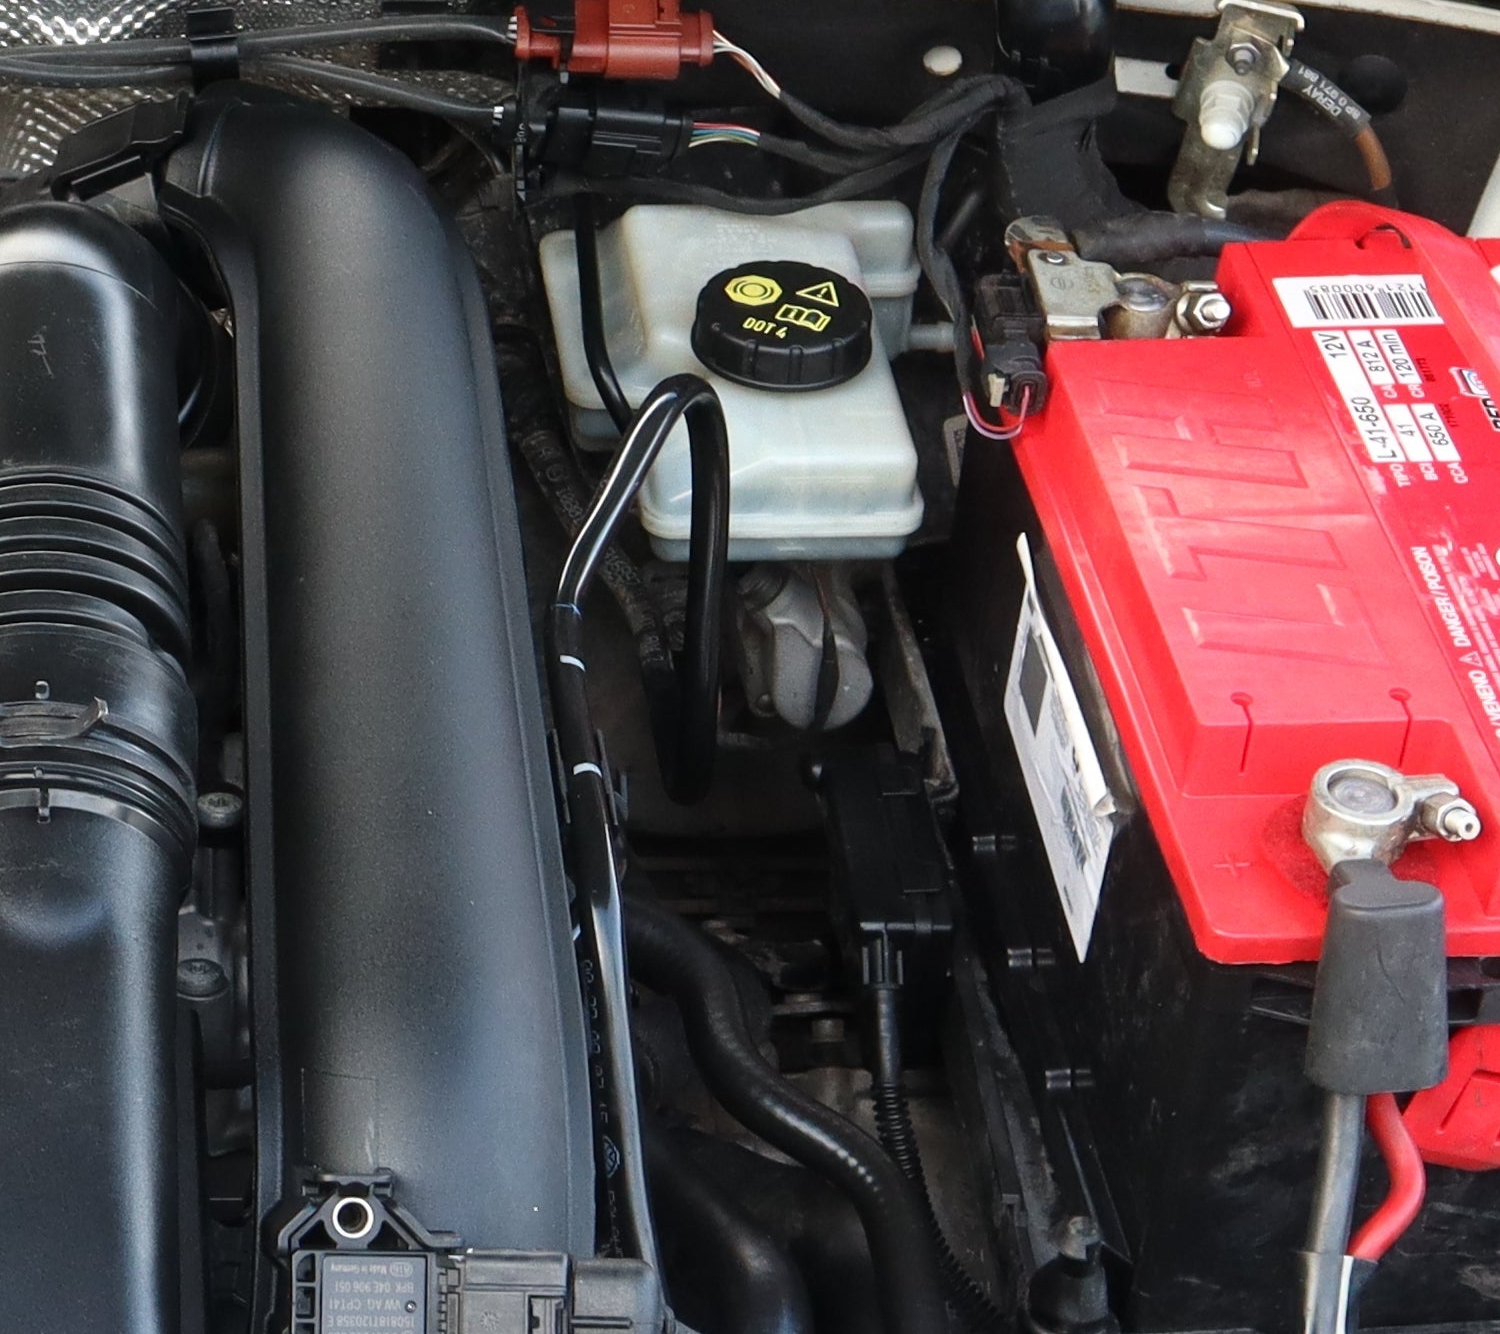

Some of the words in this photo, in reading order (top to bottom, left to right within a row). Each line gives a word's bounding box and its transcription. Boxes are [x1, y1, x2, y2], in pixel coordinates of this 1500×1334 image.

[742, 316, 775, 335] DOT
[775, 325, 788, 339] 4
[1318, 333, 1347, 358] 12V
[1356, 340, 1375, 350] A
[1383, 333, 1404, 355] min
[1363, 353, 1385, 372] 812
[1394, 357, 1415, 377] 120
[1382, 384, 1398, 399] CA
[1420, 411, 1437, 422] A
[1398, 424, 1416, 437] 41
[1428, 425, 1449, 446] 650
[1390, 463, 1411, 487] TIPO
[1448, 463, 1468, 484] CCA
[335, 1281, 351, 1292] 051
[374, 1282, 391, 1292] 04E
[395, 1282, 414, 1293] BPK
[367, 1299, 381, 1309] AG
[384, 1299, 401, 1309] VW
